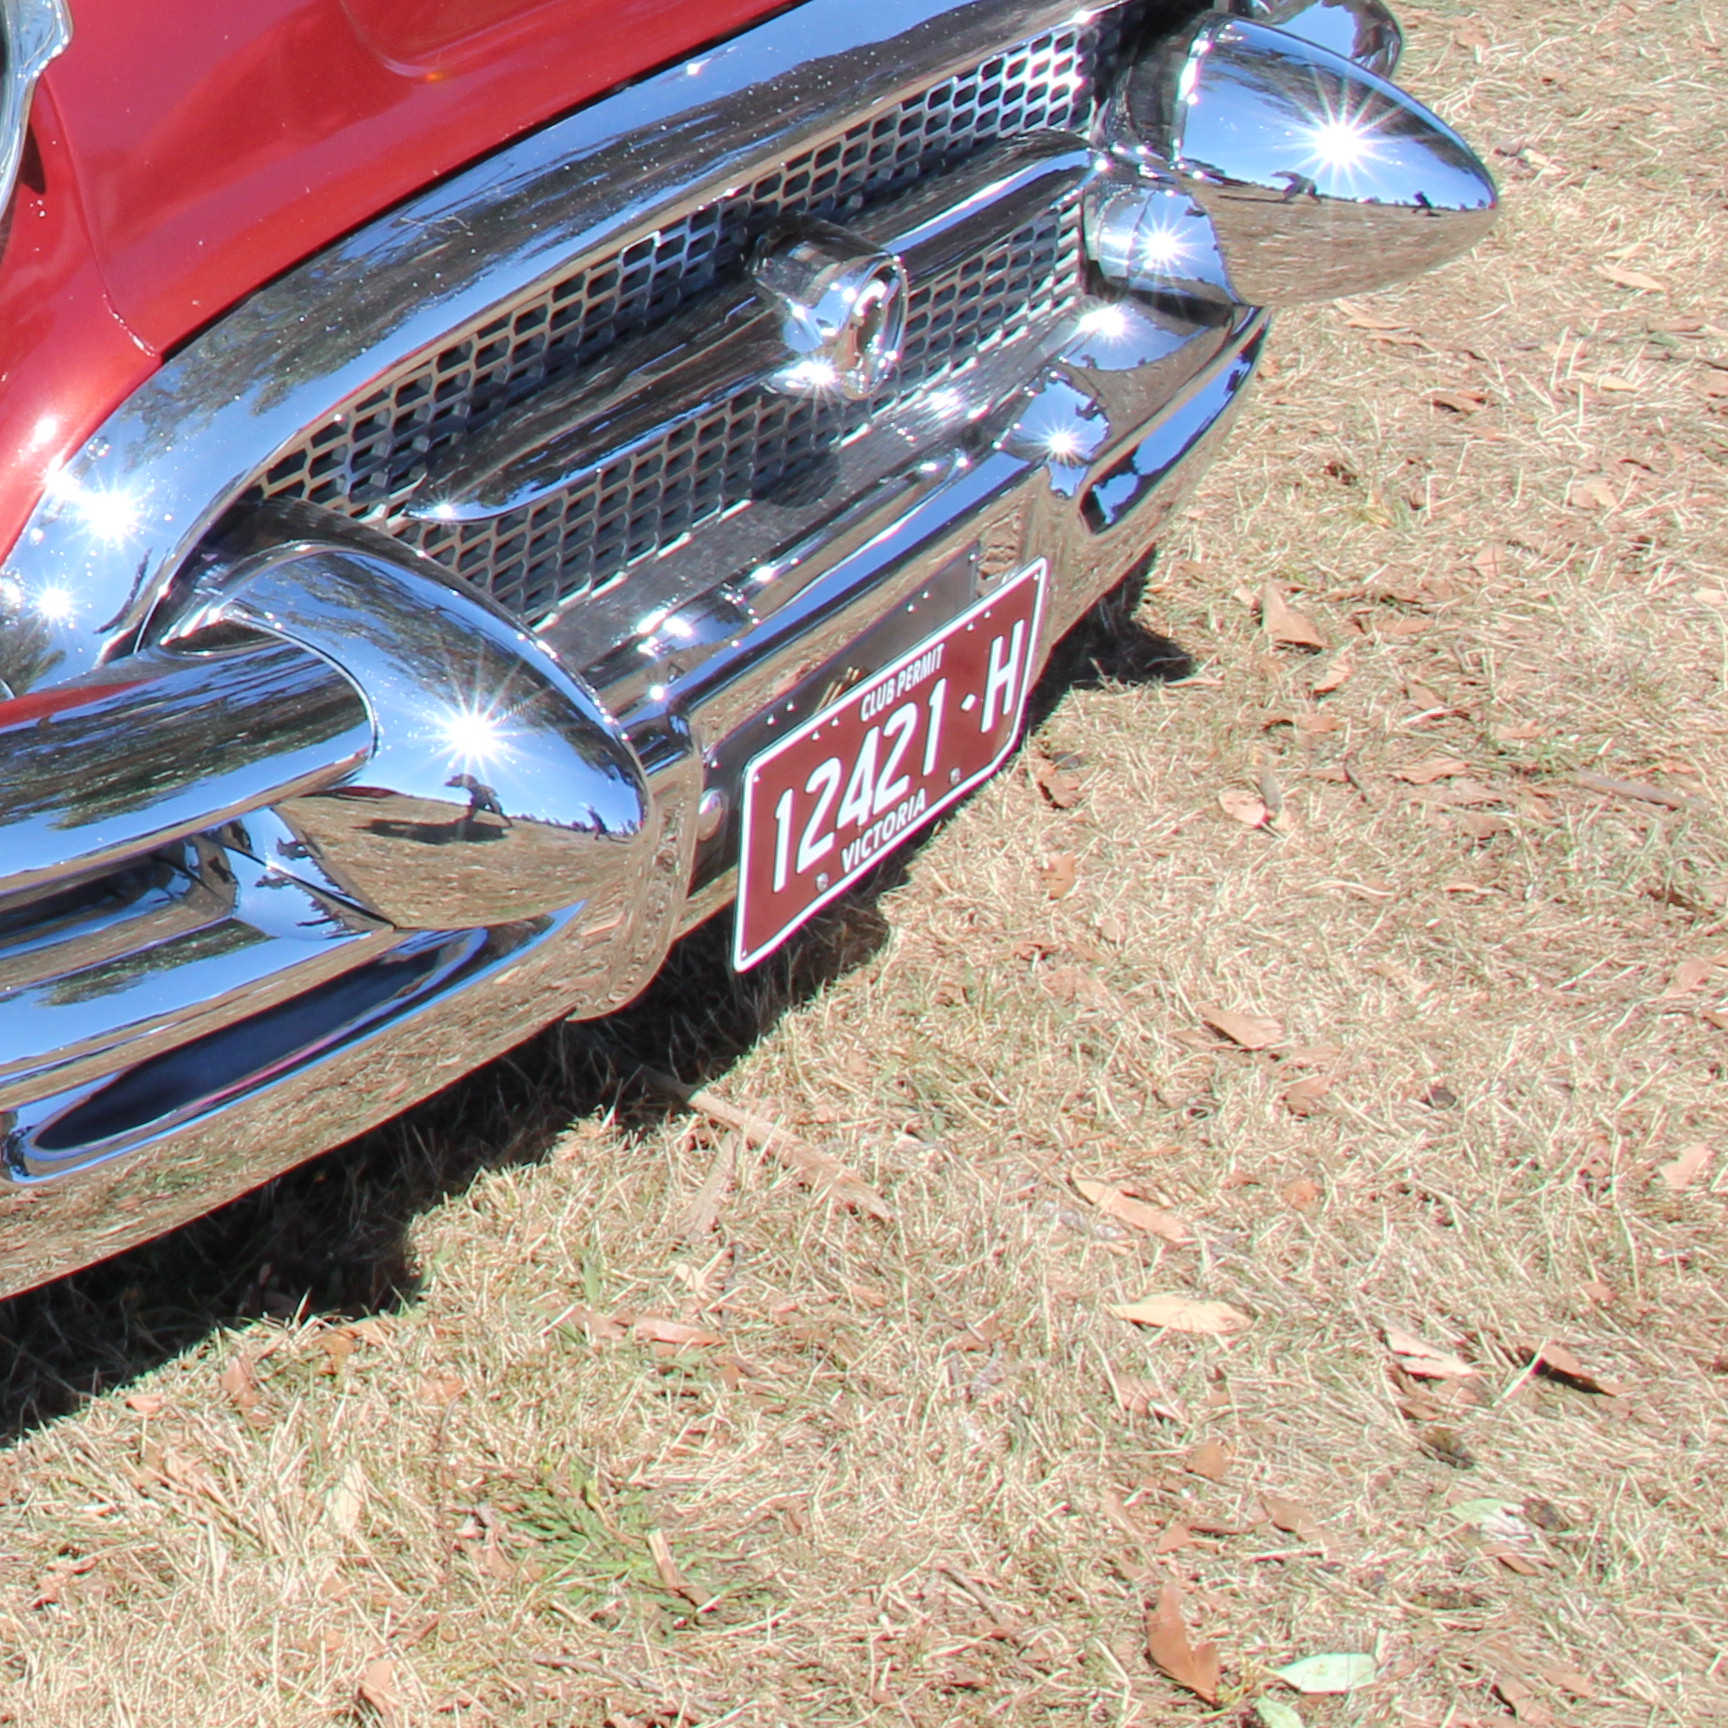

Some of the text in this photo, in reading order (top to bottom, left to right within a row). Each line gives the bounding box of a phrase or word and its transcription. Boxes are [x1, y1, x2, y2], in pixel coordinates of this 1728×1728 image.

[860, 642, 945, 723] CLUB PERMIT
[841, 787, 926, 873] VICTORIA
